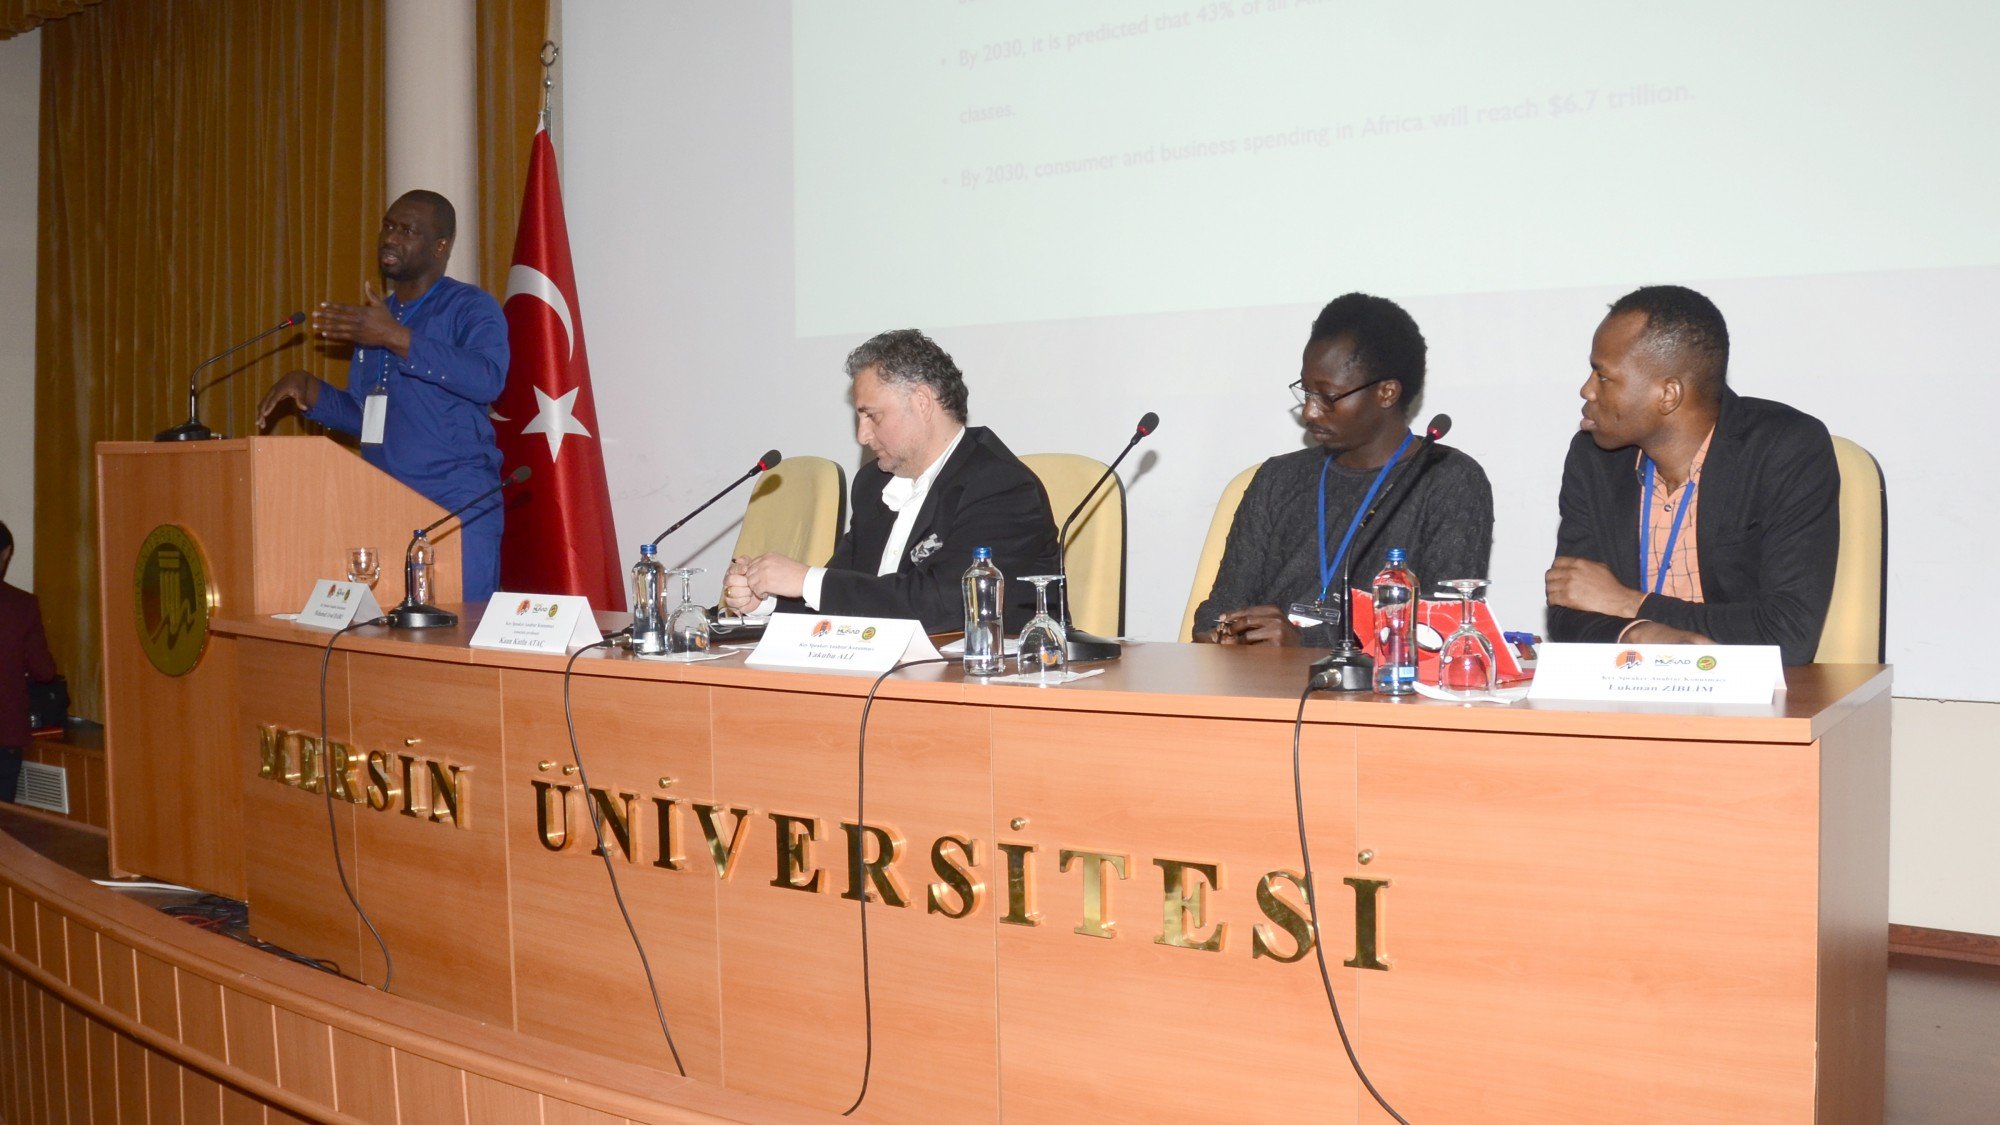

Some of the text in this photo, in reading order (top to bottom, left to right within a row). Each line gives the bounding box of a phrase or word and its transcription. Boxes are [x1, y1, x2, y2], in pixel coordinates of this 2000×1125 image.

[959, 49, 978, 71] By
[983, 38, 1027, 63] 2030,
[1032, 36, 1044, 53] it
[1049, 33, 1061, 51] is
[1066, 14, 1149, 52] predicted
[1155, 10, 1192, 32] that
[1196, 0, 1235, 23] 43%
[959, 104, 1016, 124] classes.
[961, 81, 1696, 191] By 2030, consumer and business spending in Africa will reach $6.7 trillion.
[1608, 684, 1658, 692] Lukman
[257, 724, 1393, 971] MERSİN ÜNİVERSİTESİ
